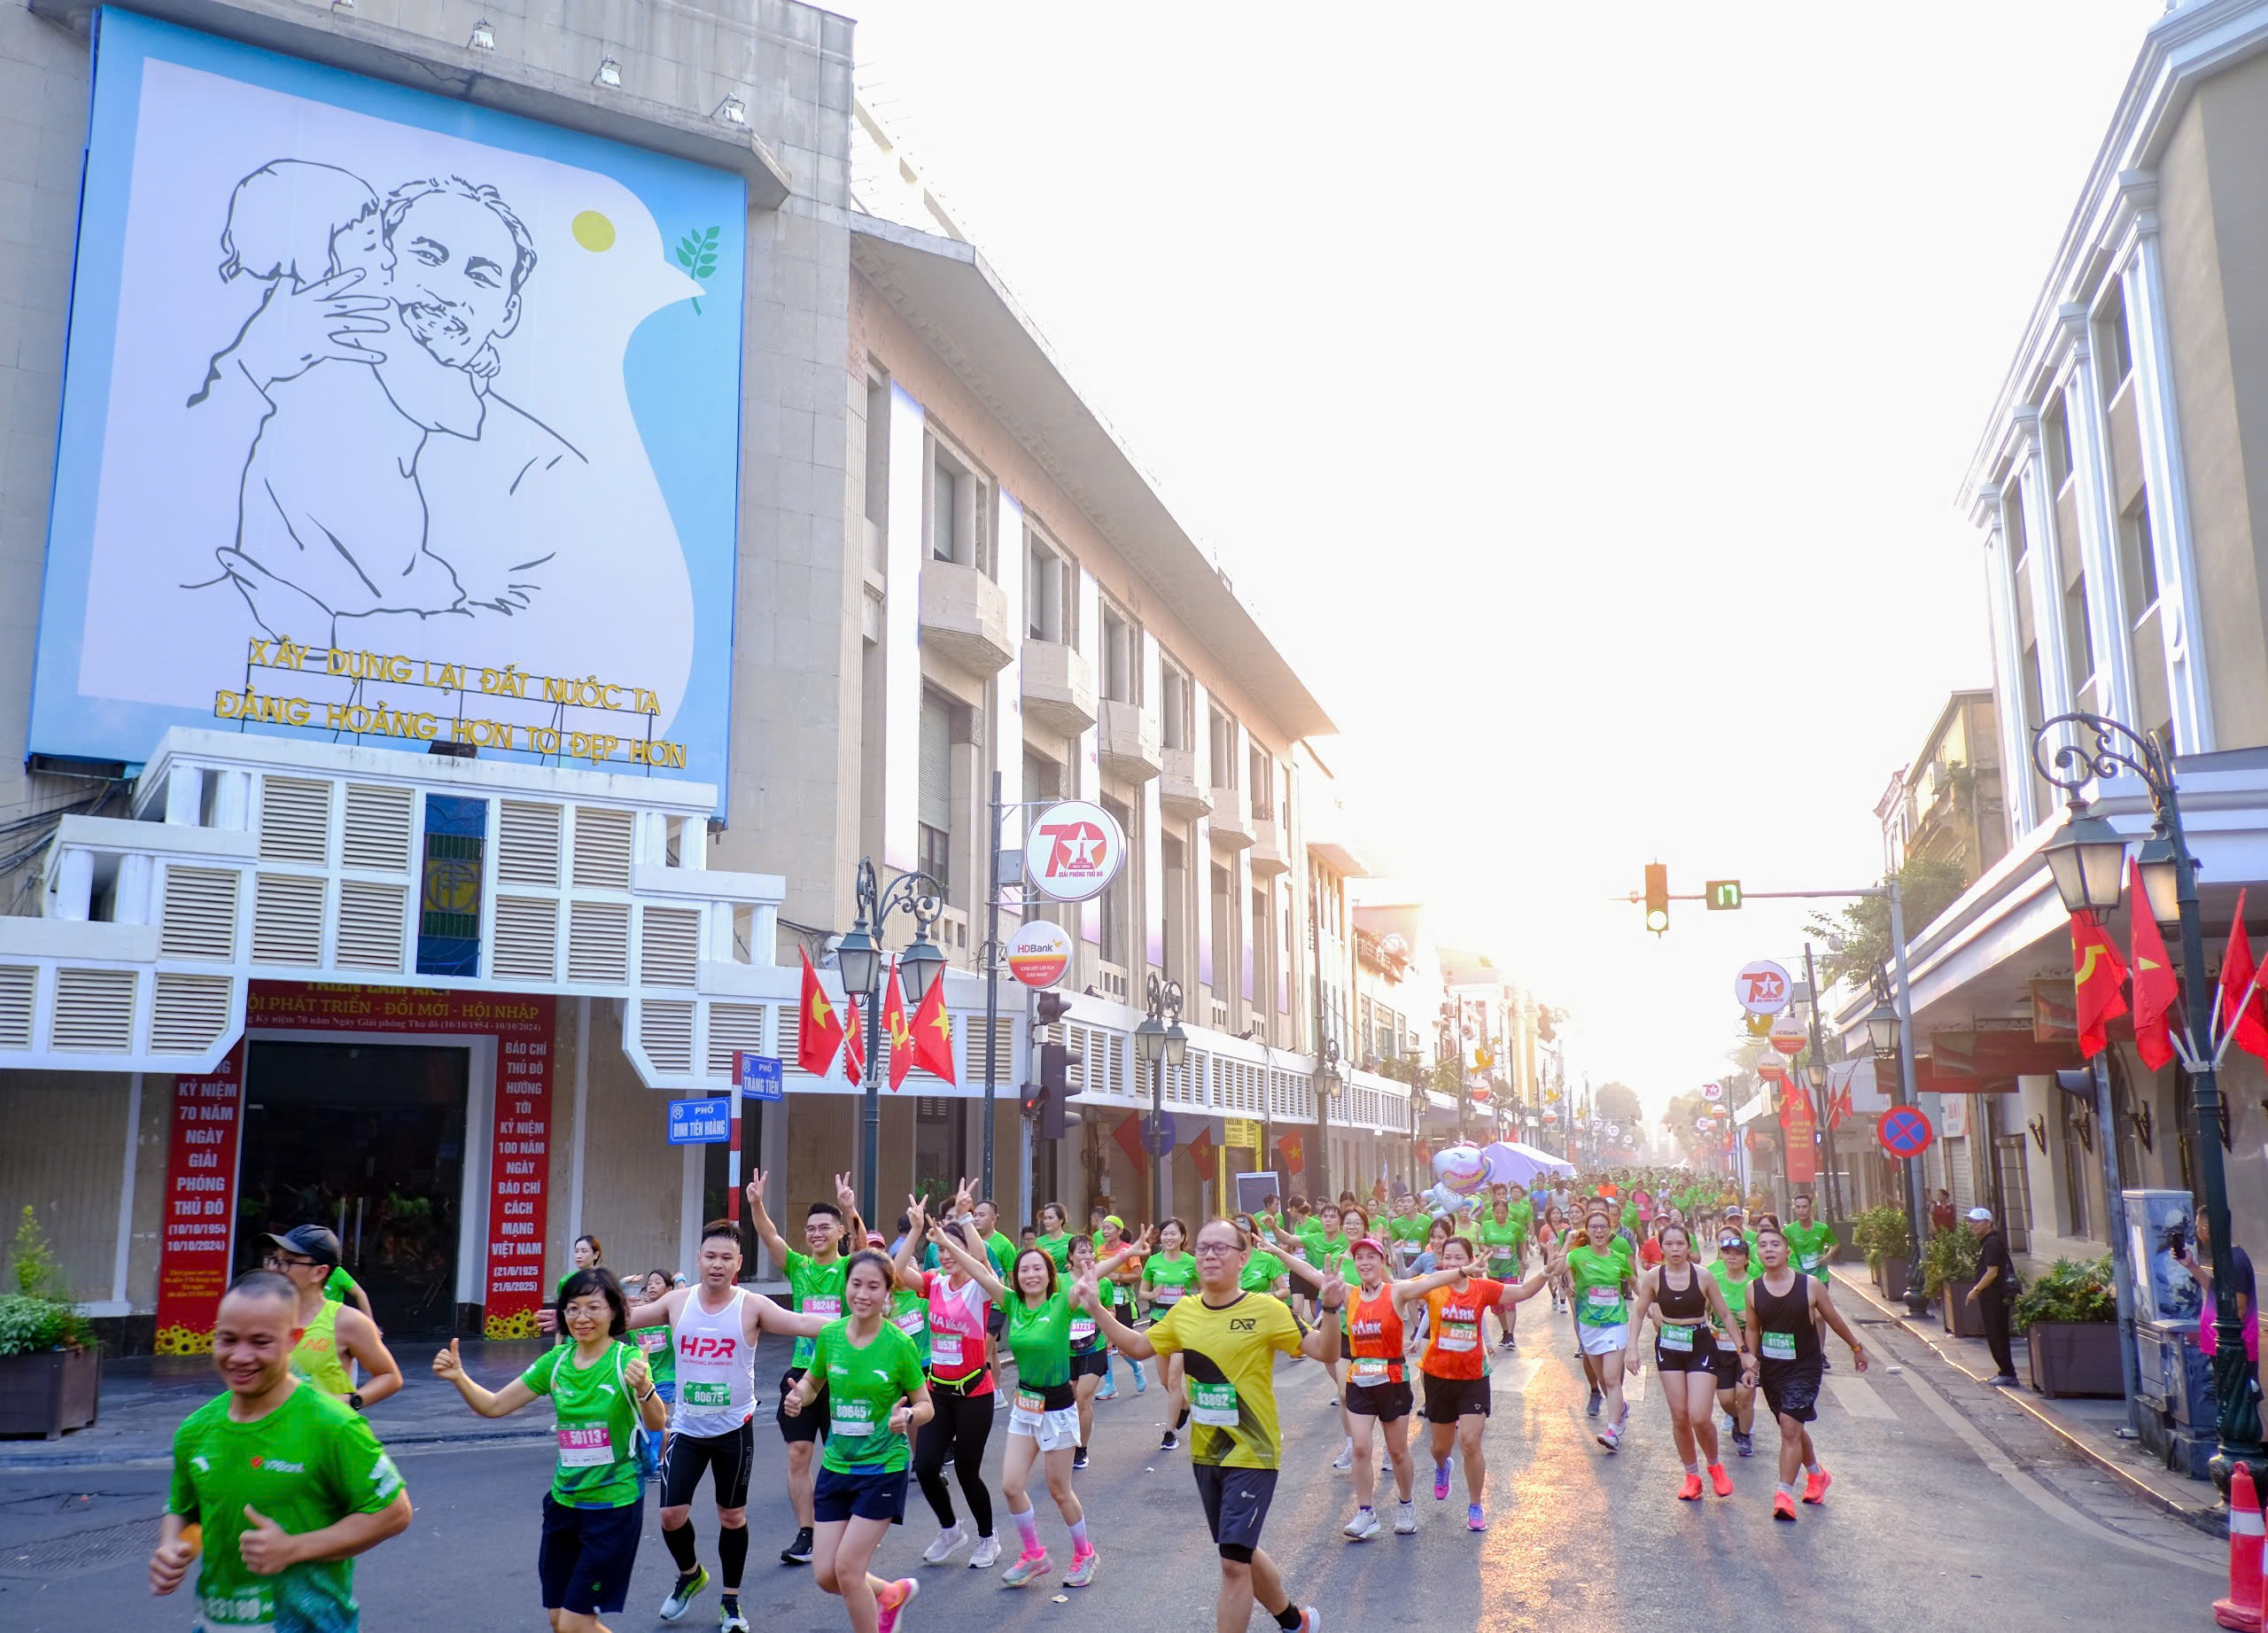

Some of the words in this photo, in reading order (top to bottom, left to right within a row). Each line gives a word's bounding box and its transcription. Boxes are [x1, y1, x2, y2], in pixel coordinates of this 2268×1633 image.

[250, 635, 309, 671] XÂY
[327, 648, 412, 685] DỰNG
[424, 660, 466, 696] LẠI
[479, 662, 530, 698] ĐẤT
[543, 675, 622, 710] NƯỚC
[633, 688, 662, 716] TA
[216, 683, 311, 726] ĐÀNG
[326, 700, 439, 740] HOÀNG
[451, 717, 513, 750] HƠN
[525, 726, 560, 754] TO
[569, 732, 618, 766] ĐẸP
[630, 737, 687, 769] HƠN
[1017, 944, 1052, 953] HDBank
[247, 992, 264, 1013] ỘI
[269, 994, 315, 1012] PHÁT
[320, 994, 371, 1015] TRIỂN
[384, 996, 414, 1016] ĐỔI
[417, 999, 449, 1016] MỚI
[462, 1001, 491, 1021] HỘI
[494, 1003, 540, 1023] NHẬP
[333, 1016, 354, 1027] Ngày
[505, 1040, 526, 1054] BÁO
[529, 1042, 547, 1055] CHÍ
[507, 1059, 527, 1075] THỦ
[529, 1061, 543, 1075] ĐÔ
[758, 1063, 773, 1073] PHỐ
[179, 1078, 198, 1097] KỶ
[200, 1080, 237, 1100] NIỆM
[506, 1080, 542, 1094] HƯỚNG
[743, 1074, 765, 1093] TRÀNG
[180, 1106, 197, 1120] 70
[200, 1103, 234, 1121] NĂM
[515, 1100, 532, 1114] TỚI
[695, 1103, 714, 1115] PHỐ
[501, 1117, 514, 1134] KỶ
[517, 1119, 545, 1137] NIỆM
[673, 1122, 688, 1137] ĐINH
[704, 1118, 726, 1135] HOÀNG
[185, 1127, 224, 1144] NGÀY
[499, 1141, 517, 1154] 100
[520, 1139, 545, 1155] NĂM
[188, 1148, 218, 1168] GIẢI
[506, 1159, 535, 1174] NGÀY
[176, 1174, 225, 1191] PHÓNG
[498, 1179, 520, 1194] BÁO
[523, 1179, 541, 1194] CHÍ
[175, 1196, 201, 1215] THỦ
[204, 1198, 224, 1216] ĐÔ
[504, 1200, 533, 1215] CÁCH
[168, 1224, 227, 1235] (10/10/1954
[501, 1222, 534, 1237] MẠNG
[167, 1240, 225, 1252] 10/10/2024)
[492, 1240, 514, 1258] VIỆT
[517, 1242, 542, 1255] NAM
[493, 1265, 539, 1277] (21/6/1925
[493, 1281, 538, 1293] 21/6/2025)
[1441, 1303, 1475, 1319] PARK
[1351, 1318, 1382, 1334] PARK
[680, 1334, 736, 1358] HPR
[694, 1391, 724, 1403] 80675
[570, 1429, 602, 1444] 50113
